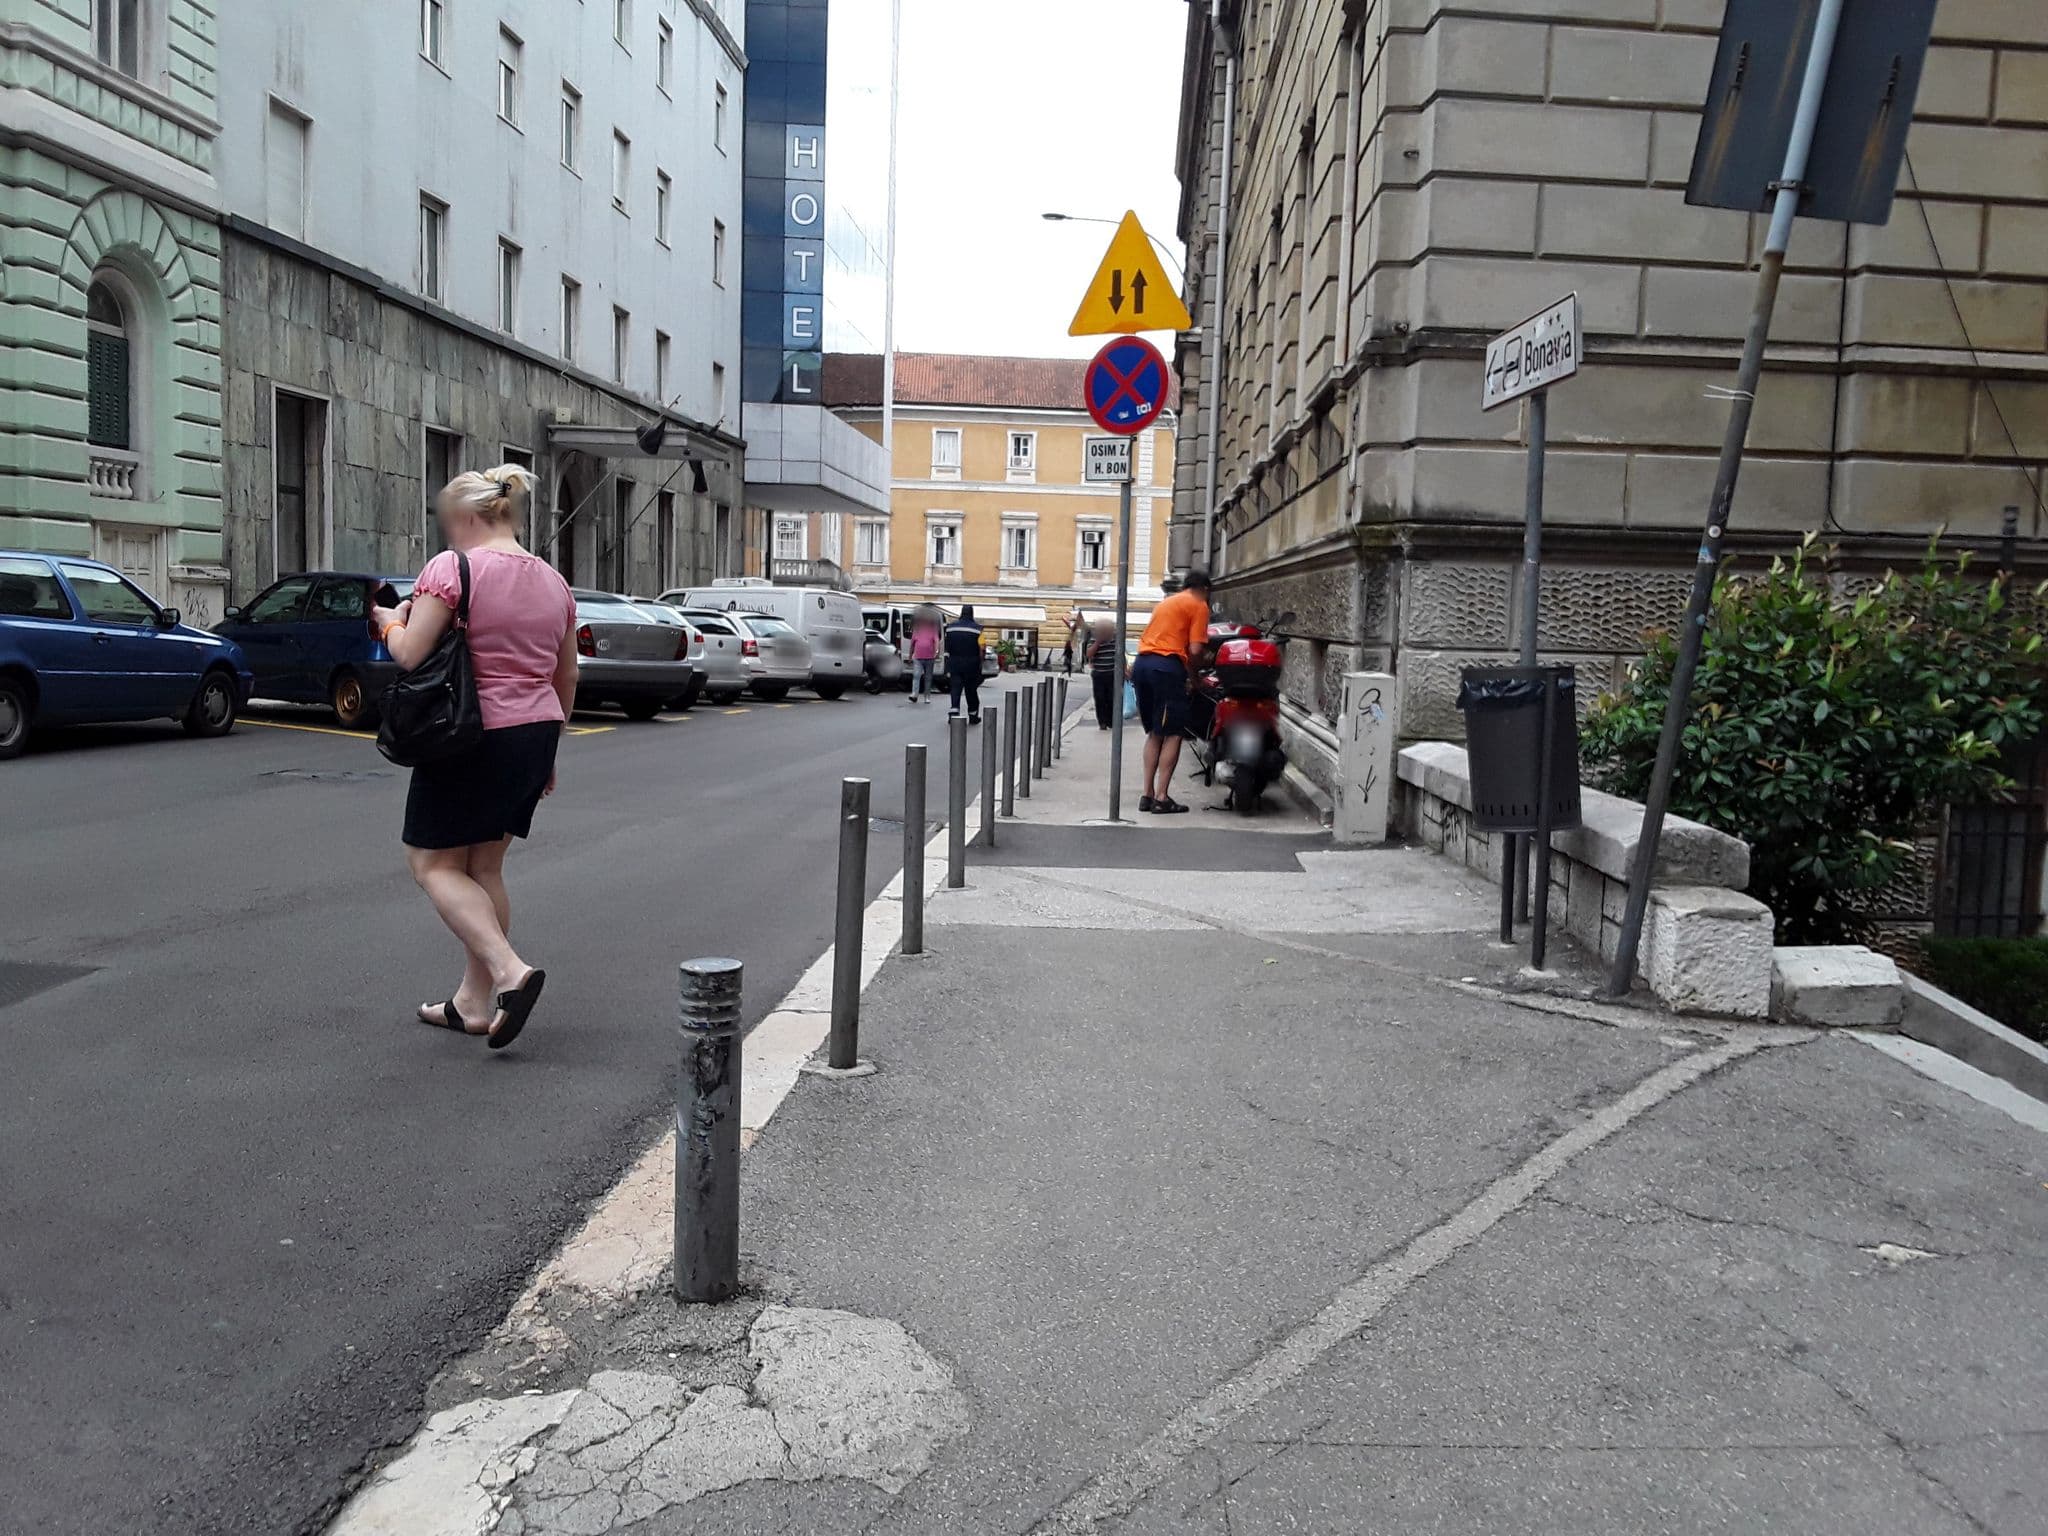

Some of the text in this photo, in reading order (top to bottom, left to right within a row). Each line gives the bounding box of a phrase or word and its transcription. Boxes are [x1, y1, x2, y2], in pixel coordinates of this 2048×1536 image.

[791, 137, 817, 393] HOTEL
[1524, 331, 1571, 376] Bonavia
[1091, 444, 1116, 457] OSIM
[1095, 462, 1104, 474] H.
